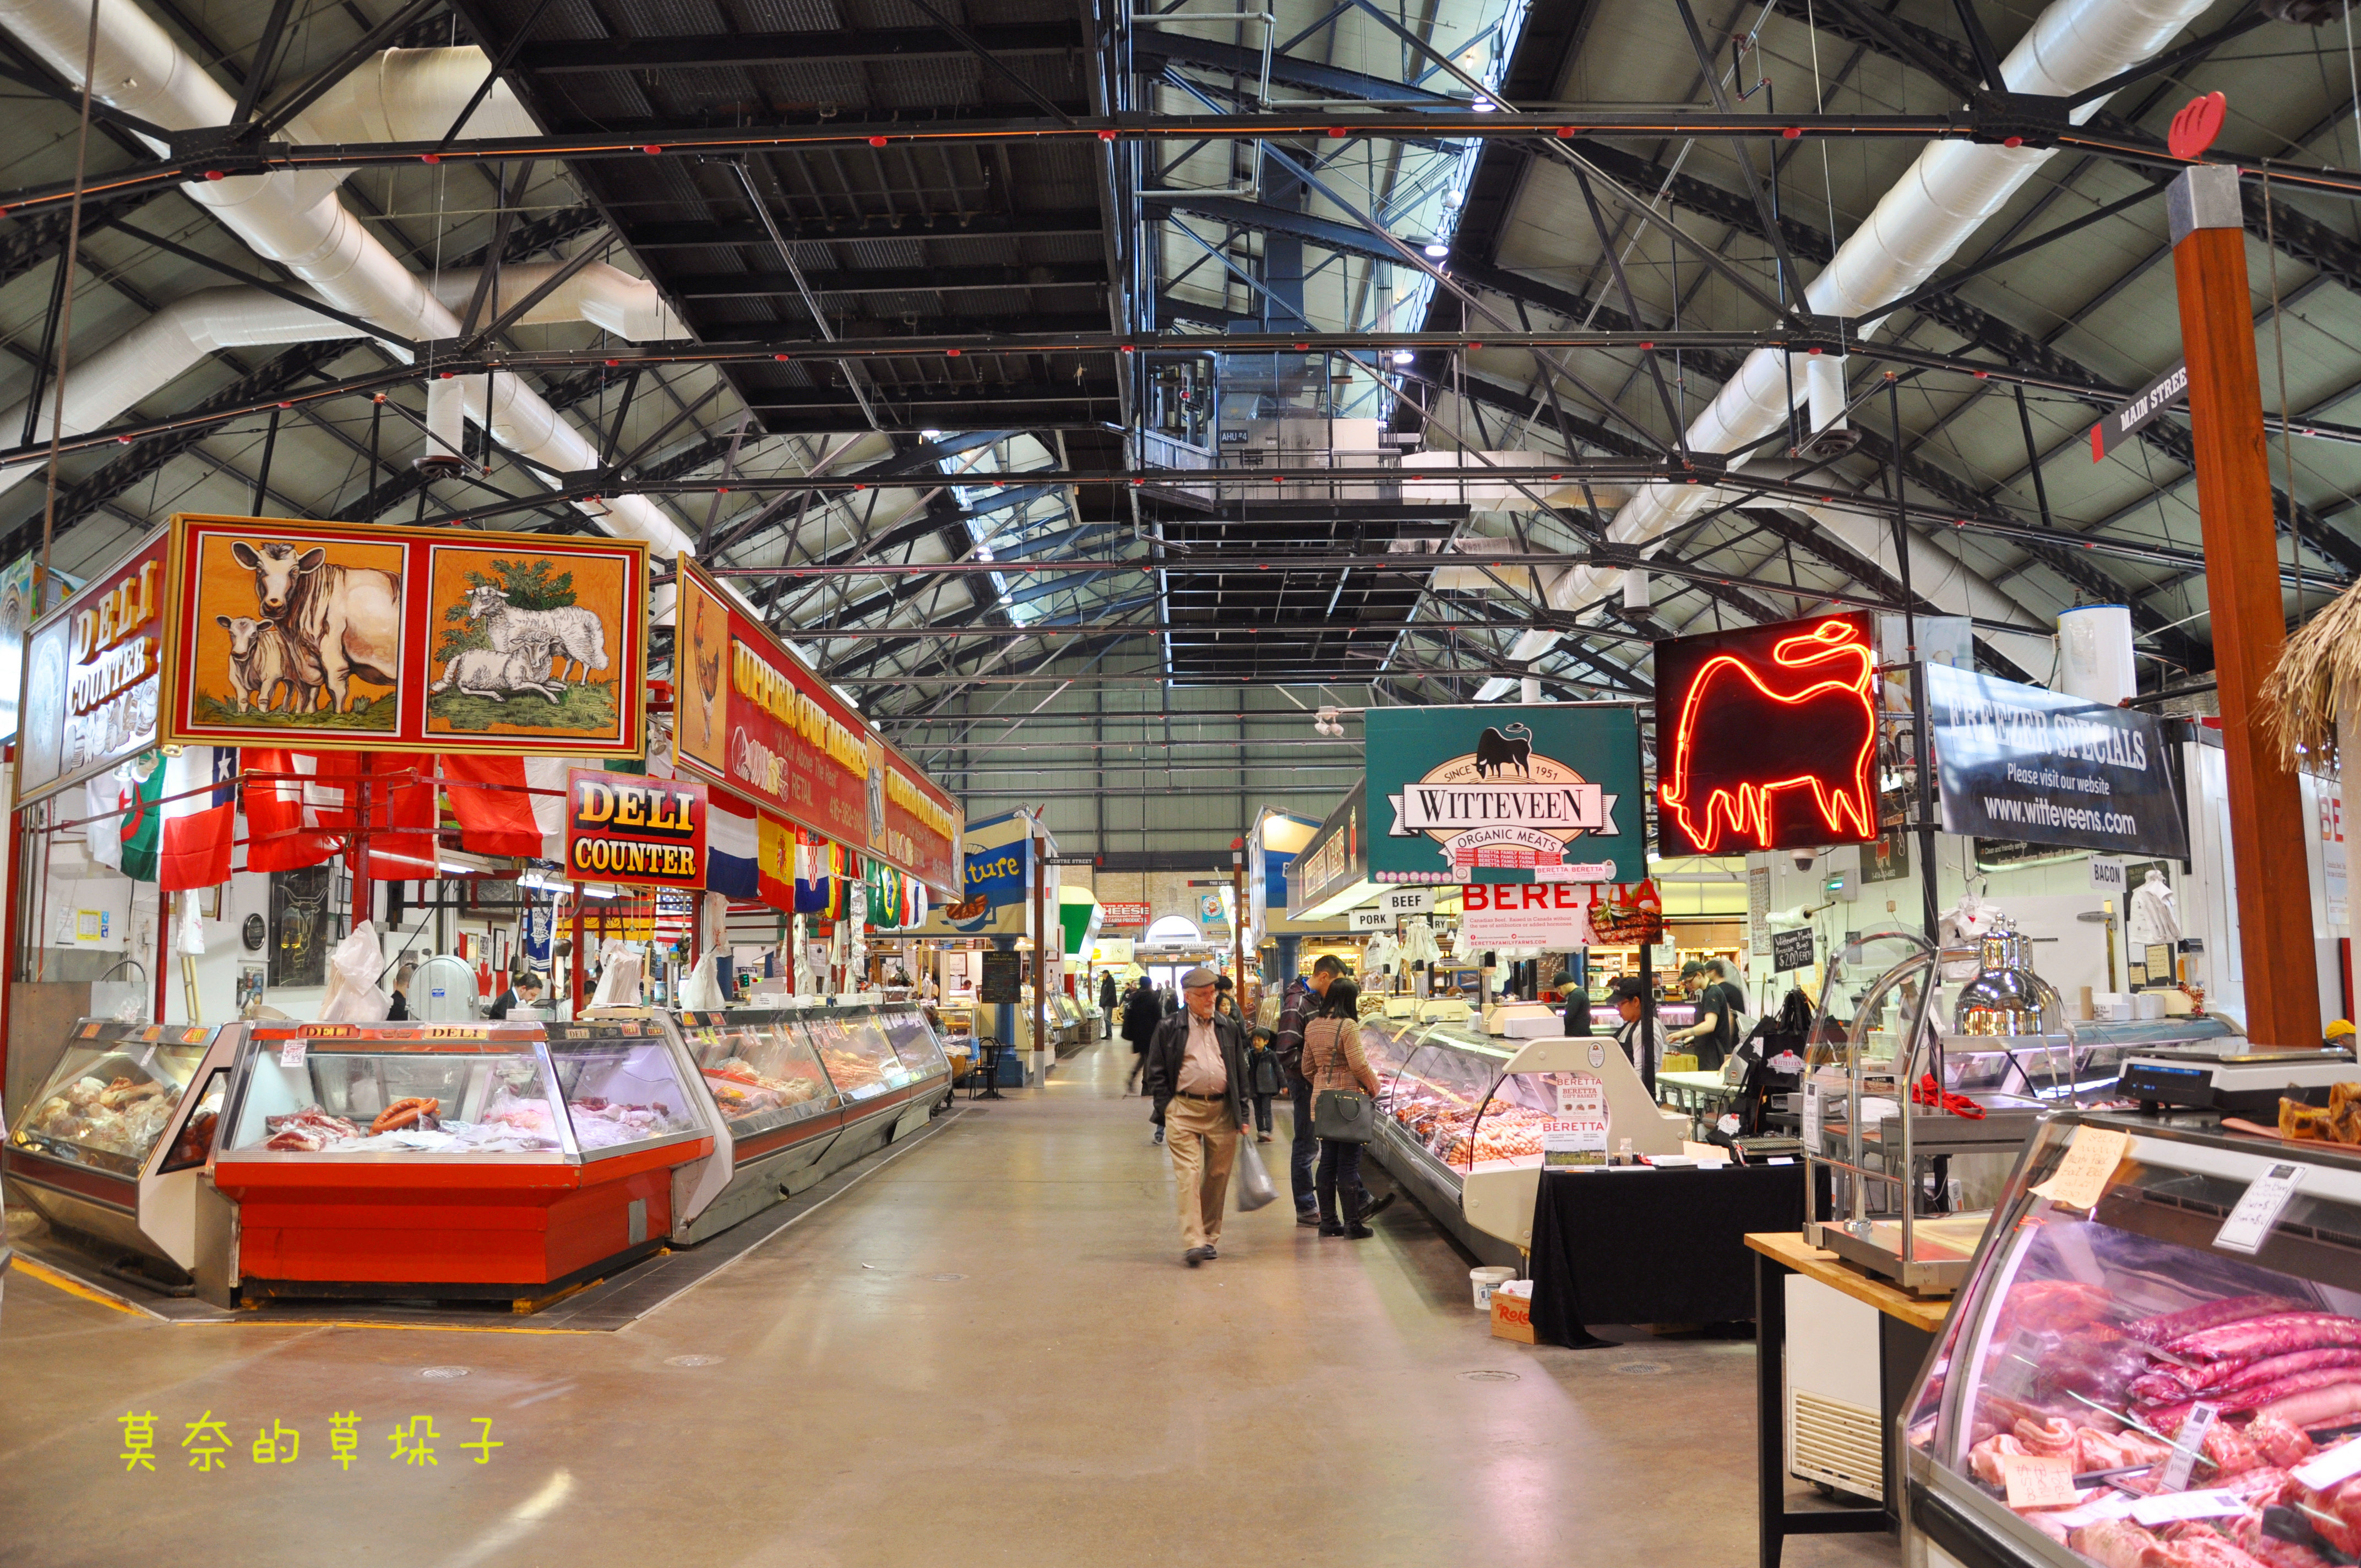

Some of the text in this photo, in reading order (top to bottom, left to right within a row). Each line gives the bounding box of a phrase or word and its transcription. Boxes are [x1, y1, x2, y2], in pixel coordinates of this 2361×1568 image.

[2120, 366, 2188, 432] MAIN STREE
[76, 559, 157, 665] DELI
[68, 636, 152, 717] COUNTER
[732, 639, 868, 780] UPPER CUT MEATS
[1947, 692, 2147, 771] FREEZER SPECIALS
[784, 735, 795, 761] Cut
[796, 744, 813, 774] Above
[815, 756, 824, 781] The
[1444, 765, 1558, 782] SINCE 1951
[2008, 763, 2110, 796] Please visit our website
[792, 771, 813, 808] RETAIL
[886, 765, 916, 816] UPPER
[576, 780, 694, 832] DELI
[1417, 790, 1584, 823] WITTEVEEN
[1984, 797, 2137, 836] www.witteveens.com
[1457, 829, 1557, 852] ORGANIC MEATS
[575, 837, 696, 876] COUNTER
[964, 857, 1020, 884] ture
[2094, 864, 2121, 883] BACON
[1392, 895, 1422, 908] BEEF
[1462, 878, 1662, 911] BERETTA
[1360, 914, 1386, 924] PORK
[1796, 941, 1809, 950] Bags
[1797, 930, 1812, 941] Meats
[189, 1031, 205, 1040] HAM
[306, 1027, 351, 1037] DELI
[432, 1028, 478, 1038] DELI
[569, 1030, 587, 1038] DELI
[1774, 1058, 1802, 1067] WITTEVEEN
[1543, 1122, 1604, 1132] BERETTA
